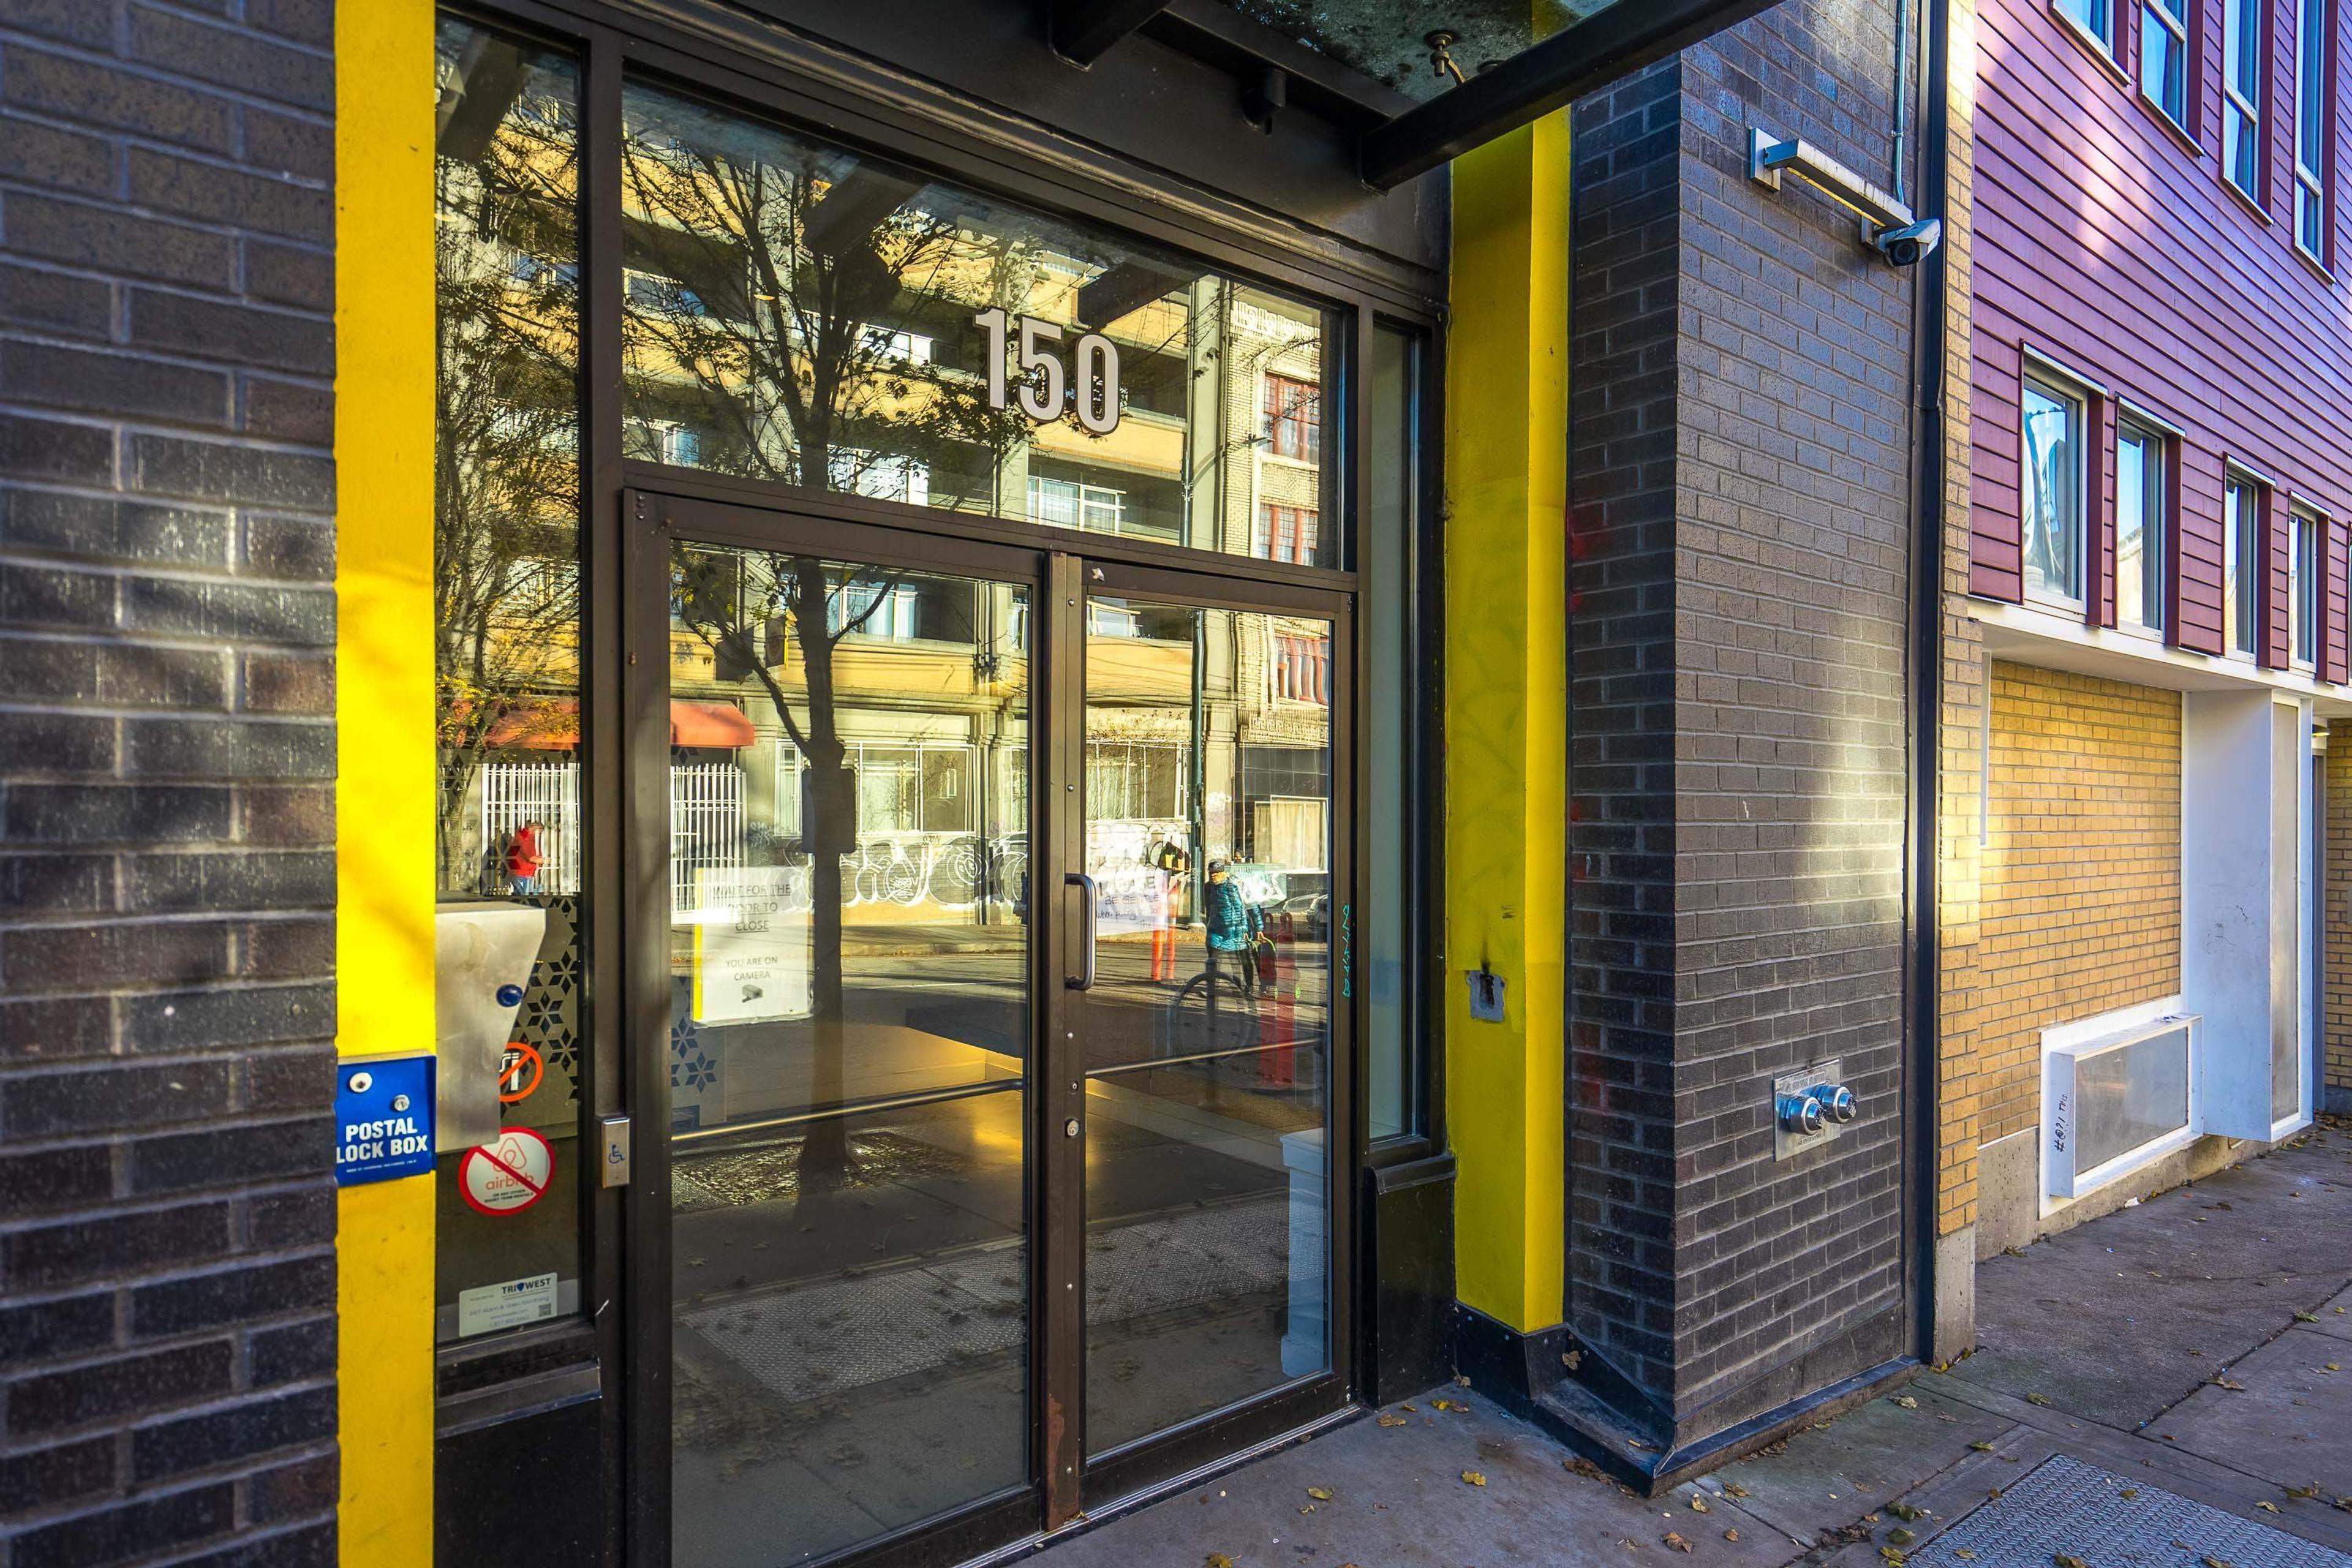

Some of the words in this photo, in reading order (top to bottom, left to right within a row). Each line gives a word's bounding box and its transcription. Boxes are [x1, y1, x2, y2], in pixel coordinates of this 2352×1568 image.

[973, 306, 1120, 434] 150
[747, 885, 766, 895] FOR
[771, 884, 791, 895] THE
[762, 902, 778, 912] TO
[735, 920, 769, 932] CLOSE
[725, 958, 744, 968] YOU
[747, 957, 763, 966] ARE
[764, 956, 778, 965] ON
[734, 970, 771, 981] CAMERA
[346, 1117, 418, 1142] POSTAL
[336, 1141, 384, 1164] LOCK
[390, 1135, 428, 1156] BOX
[485, 1172, 534, 1191] airbb
